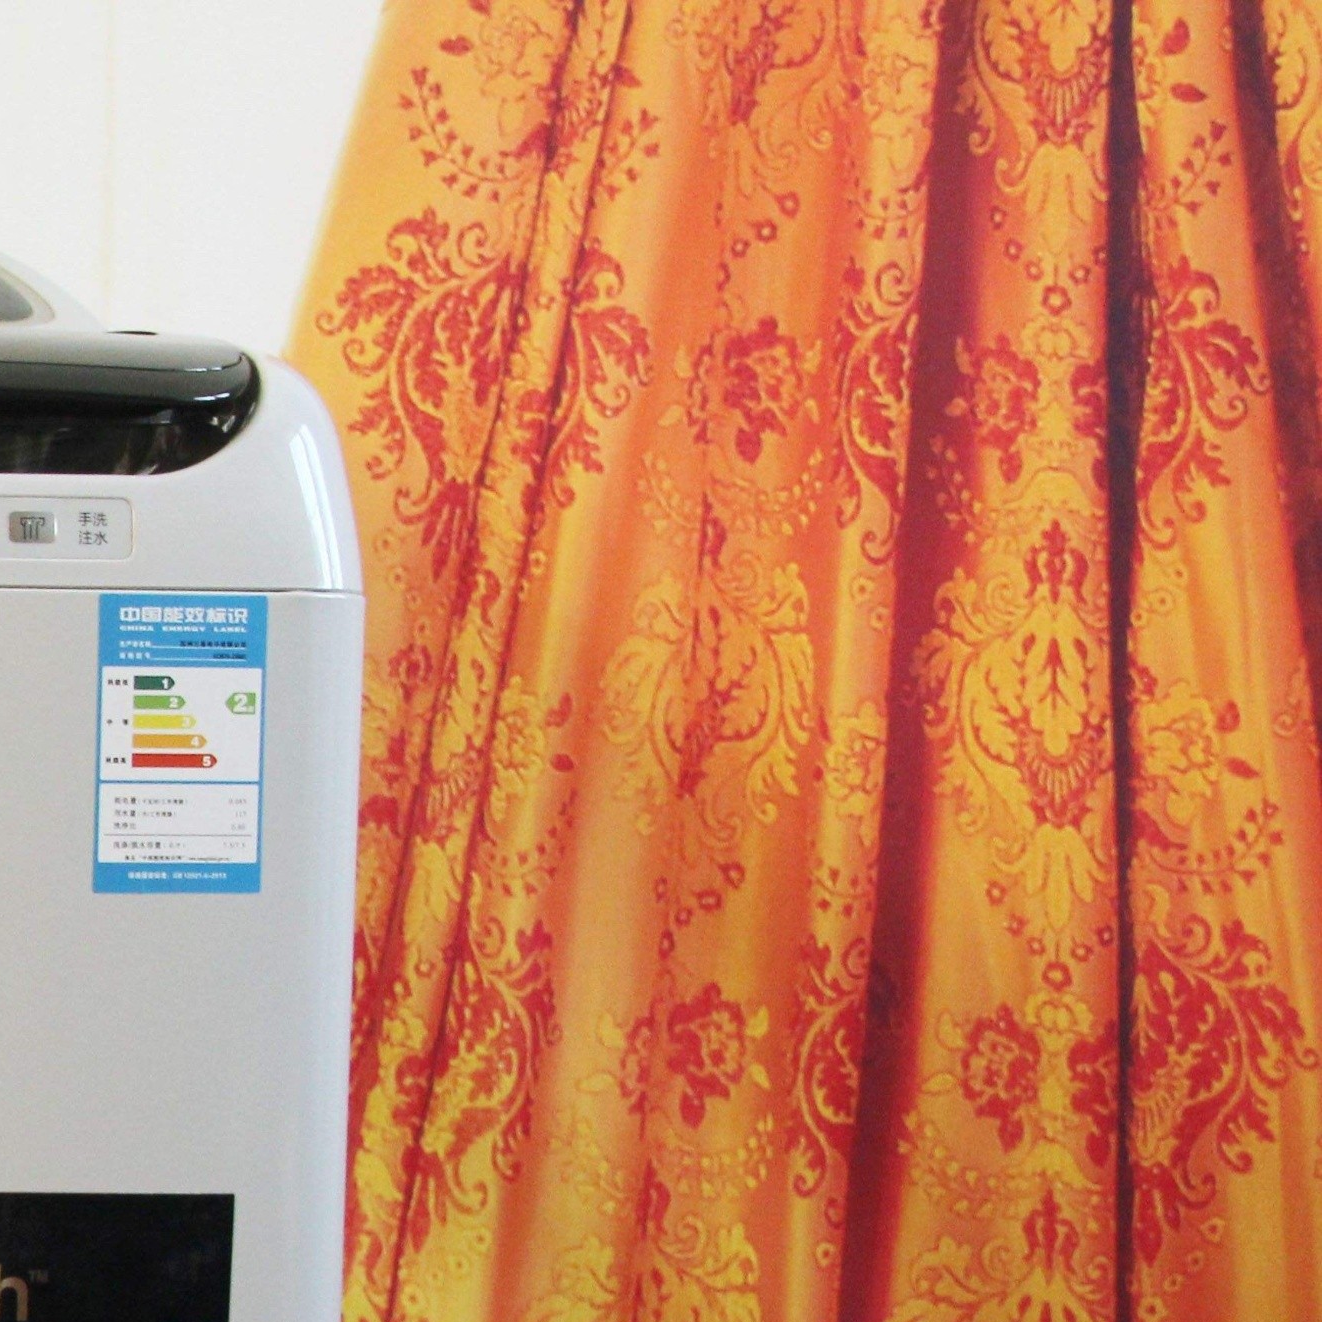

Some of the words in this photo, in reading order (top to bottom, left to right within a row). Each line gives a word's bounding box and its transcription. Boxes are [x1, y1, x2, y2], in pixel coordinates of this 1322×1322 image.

[78, 512, 108, 527] 手洗
[78, 531, 108, 545] 注水
[119, 607, 248, 624] 中国能效标识
[161, 678, 169, 689] 1
[169, 697, 179, 708] 2
[190, 736, 200, 747] 4
[202, 756, 212, 767] 5
